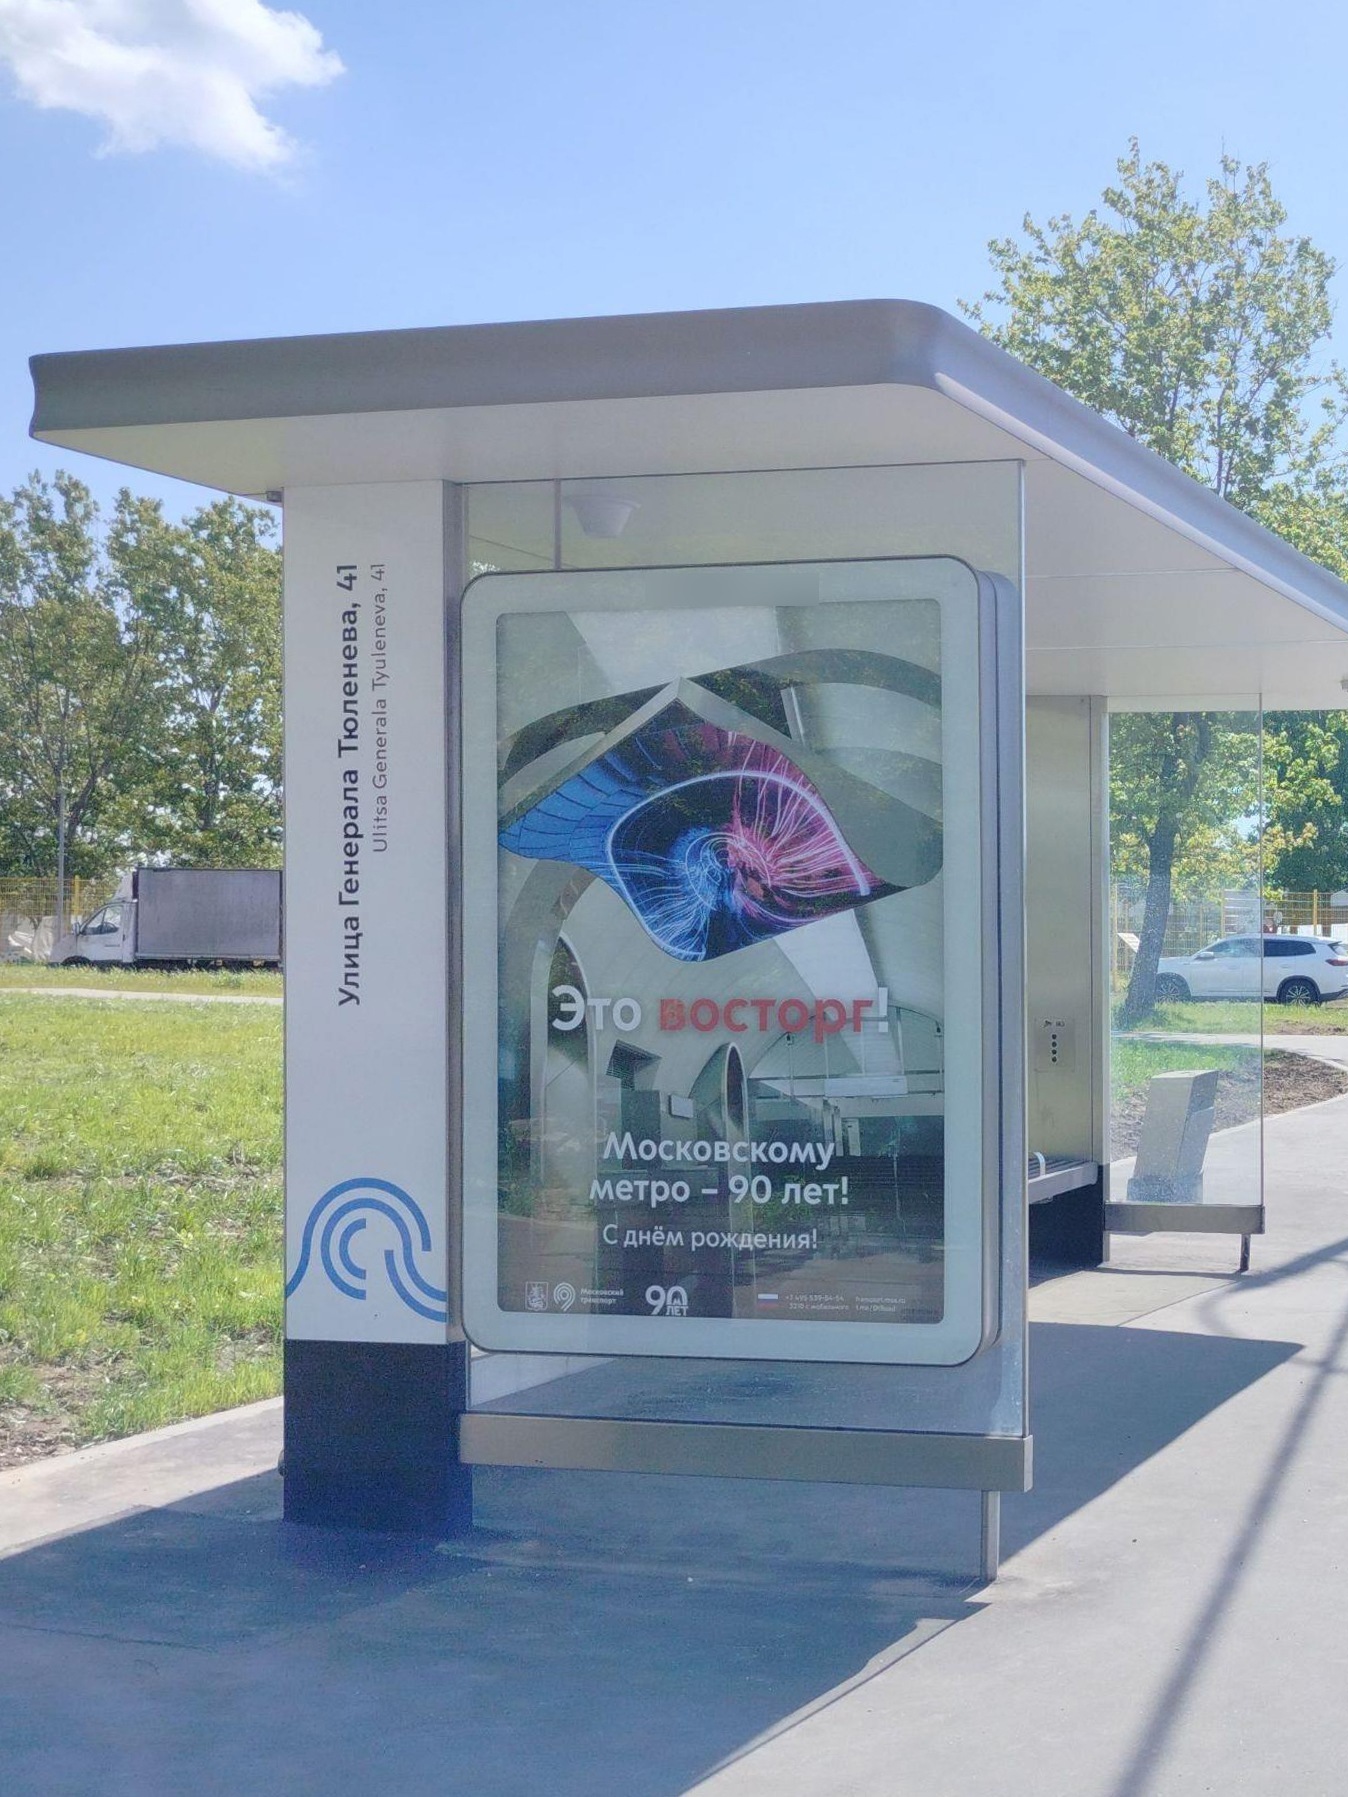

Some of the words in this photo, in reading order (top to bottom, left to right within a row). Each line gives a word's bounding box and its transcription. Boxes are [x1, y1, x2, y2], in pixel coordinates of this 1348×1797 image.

[336, 564, 358, 591] 41
[370, 563, 386, 581] 41
[371, 588, 390, 691] Tyuleneva,
[338, 603, 361, 758] Тюленева,
[371, 698, 387, 789] Generala
[338, 769, 364, 906] Генерала
[371, 795, 388, 852] Ulitsa
[338, 916, 363, 1006] Улица
[551, 984, 641, 1031] Это
[660, 987, 889, 1043] восторг!
[603, 1132, 835, 1169] Московскому
[589, 1177, 691, 1207] метро
[729, 1175, 772, 1204] 90
[781, 1176, 850, 1206] лет!
[602, 1224, 618, 1245] С
[623, 1225, 684, 1248] днём
[690, 1228, 818, 1251] рождения!
[665, 1306, 689, 1316] ЛЕТ
